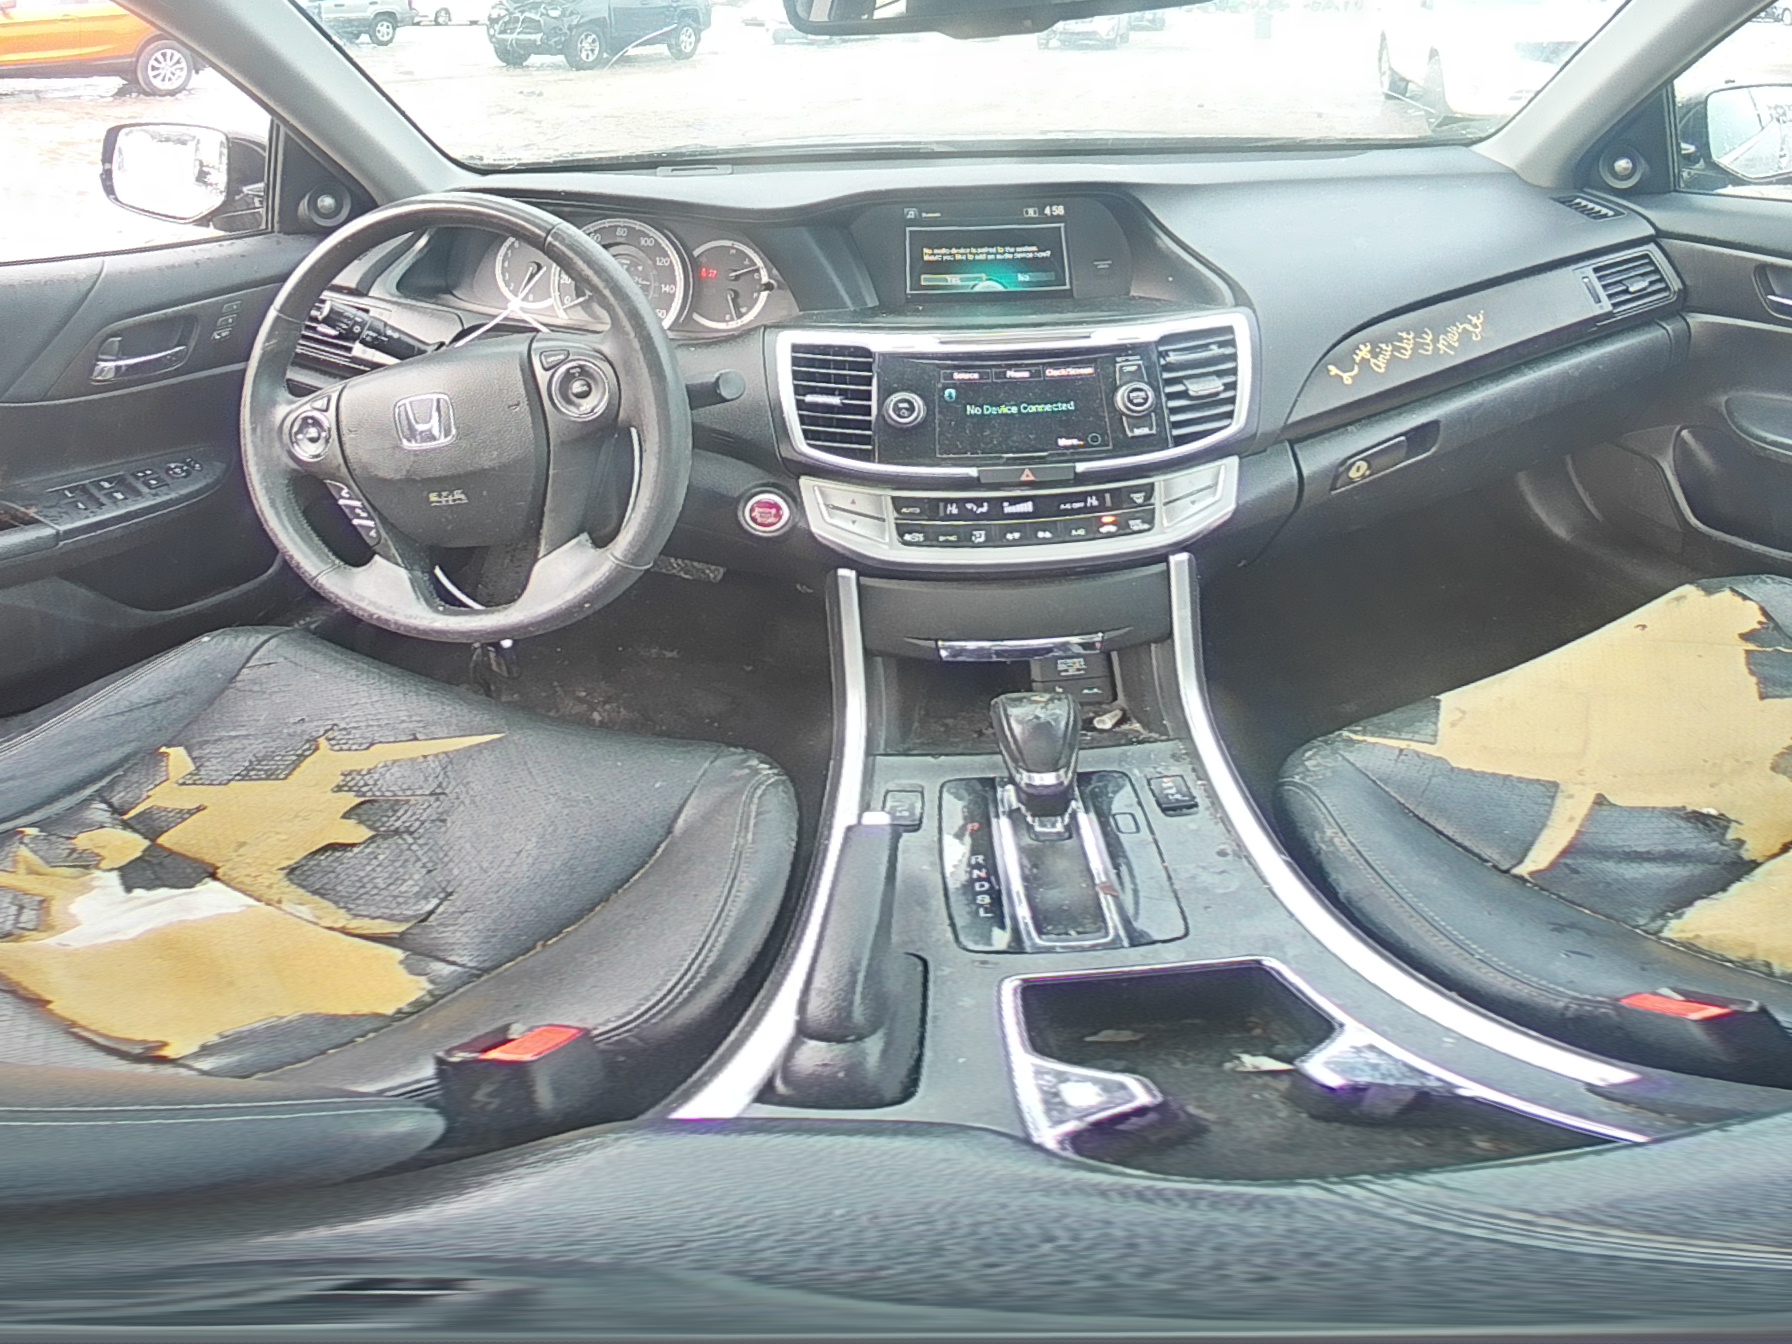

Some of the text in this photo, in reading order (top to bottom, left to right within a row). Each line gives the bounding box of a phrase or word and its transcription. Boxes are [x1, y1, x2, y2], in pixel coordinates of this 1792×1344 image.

[615, 227, 628, 237] 80
[639, 236, 655, 247] 100
[655, 256, 671, 267] 120
[661, 283, 676, 294] 140
[966, 401, 1075, 415] No Device Connected
[967, 822, 980, 834] P
[970, 854, 985, 865] R
[973, 868, 988, 879] N
[973, 881, 990, 892] D
[979, 907, 994, 918] L
